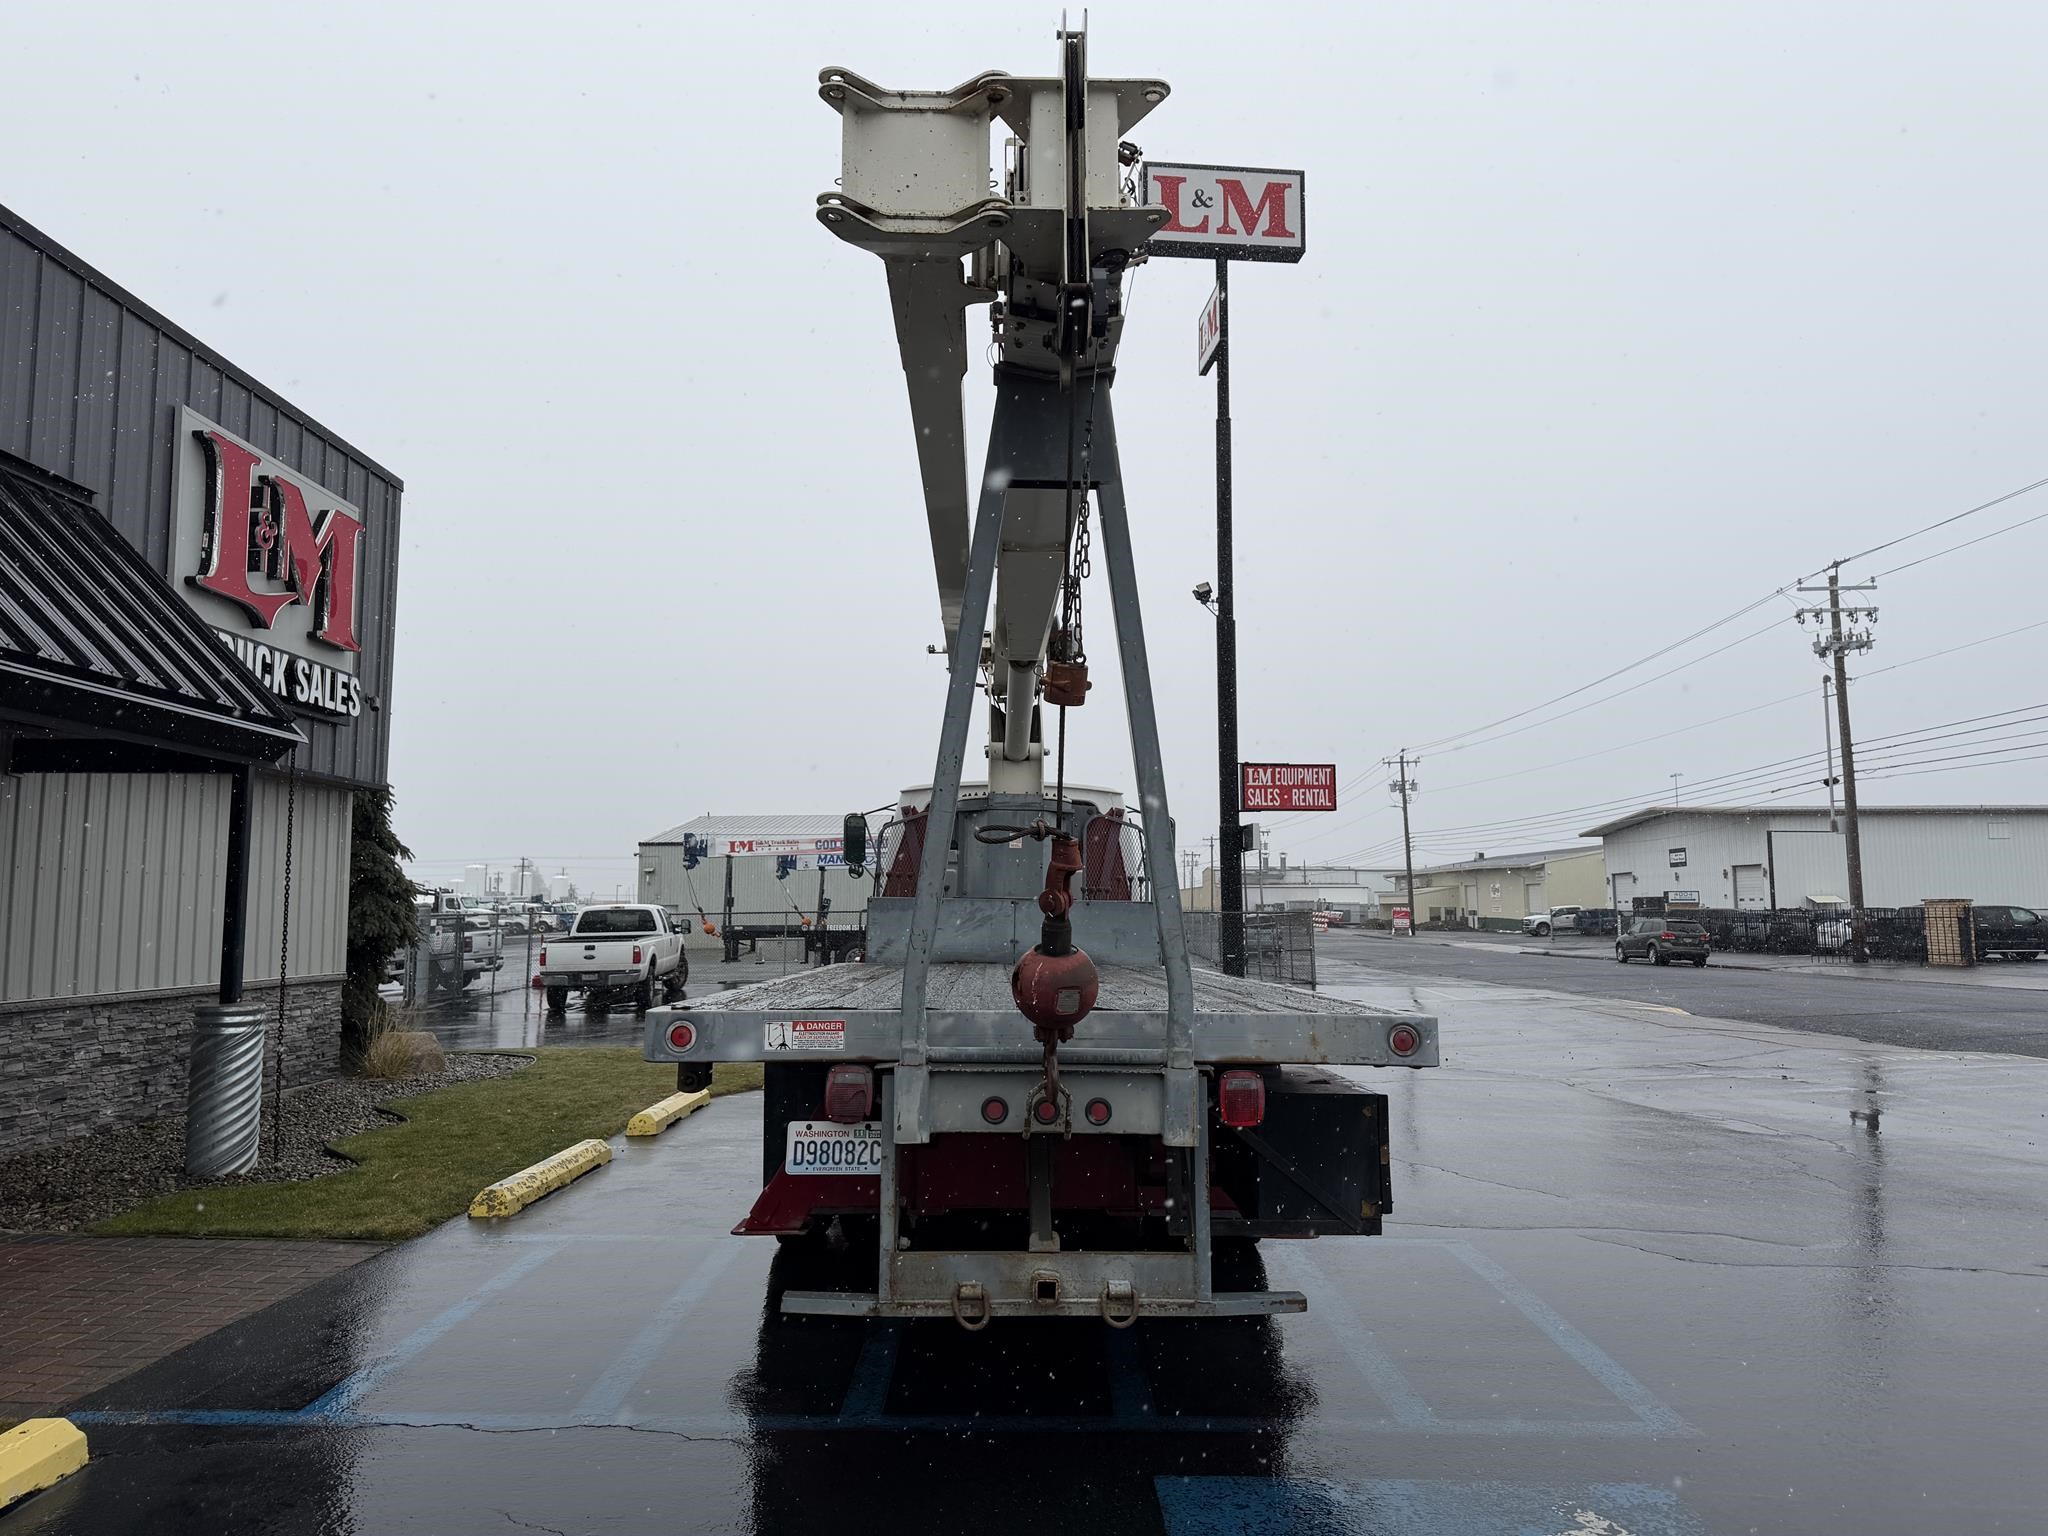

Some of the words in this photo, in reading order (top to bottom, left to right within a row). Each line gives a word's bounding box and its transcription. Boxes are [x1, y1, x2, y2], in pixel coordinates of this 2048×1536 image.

[1153, 175, 1295, 238] L&M
[190, 430, 366, 652] L&M
[295, 658, 361, 717] SALES
[1246, 767, 1273, 786] L&M
[1275, 767, 1332, 787] EQUIPMENT
[1247, 788, 1281, 806] SALES
[1292, 788, 1332, 806] RENTAL
[815, 839, 837, 850] GOD
[806, 1022, 842, 1030] DANGER
[795, 1130, 850, 1138] WASHINGTON
[793, 1140, 881, 1166] D98082C
